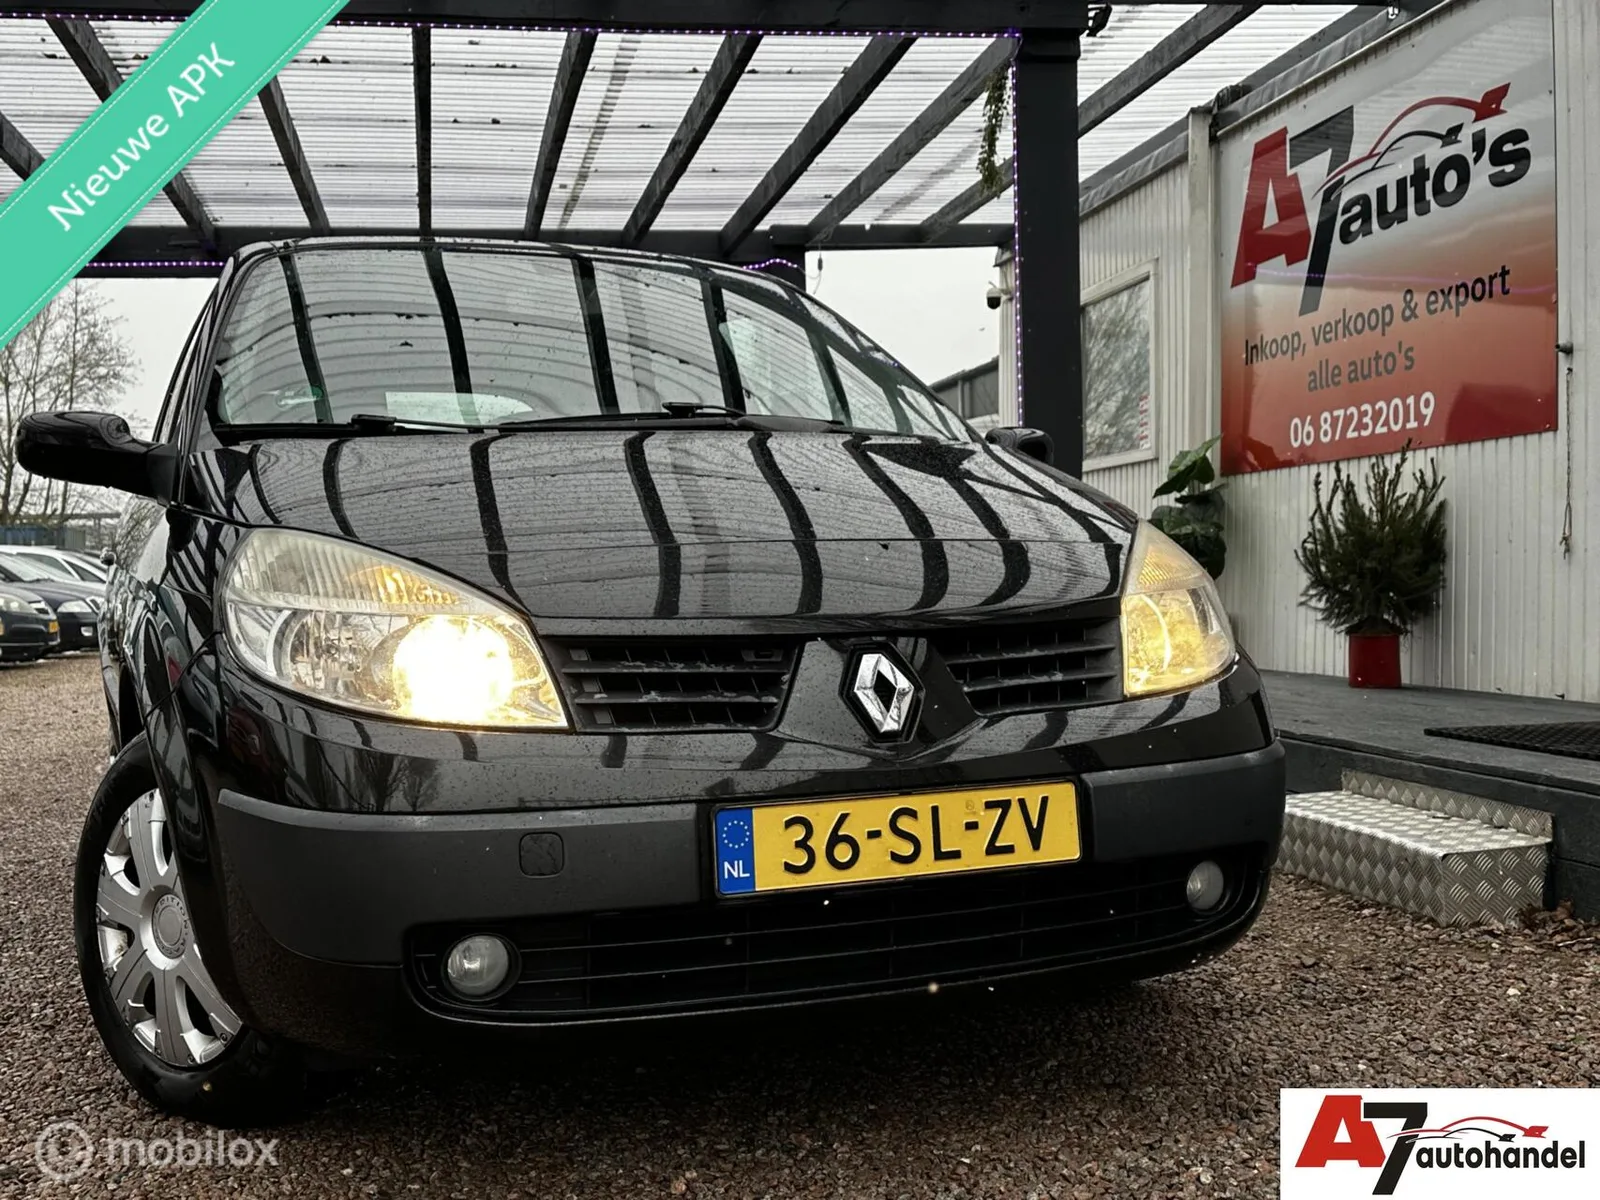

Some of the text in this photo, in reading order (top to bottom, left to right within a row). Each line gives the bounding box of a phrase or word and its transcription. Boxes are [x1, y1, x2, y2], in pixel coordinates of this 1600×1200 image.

[1231, 105, 1532, 317] A7 auto's
[1245, 265, 1511, 366] Inkoop, verkoop & export
[1307, 341, 1415, 393] alle auto's
[1290, 391, 1436, 448] 06 87232019
[783, 795, 1050, 875] 36-SL-ZV
[724, 860, 750, 880] NL
